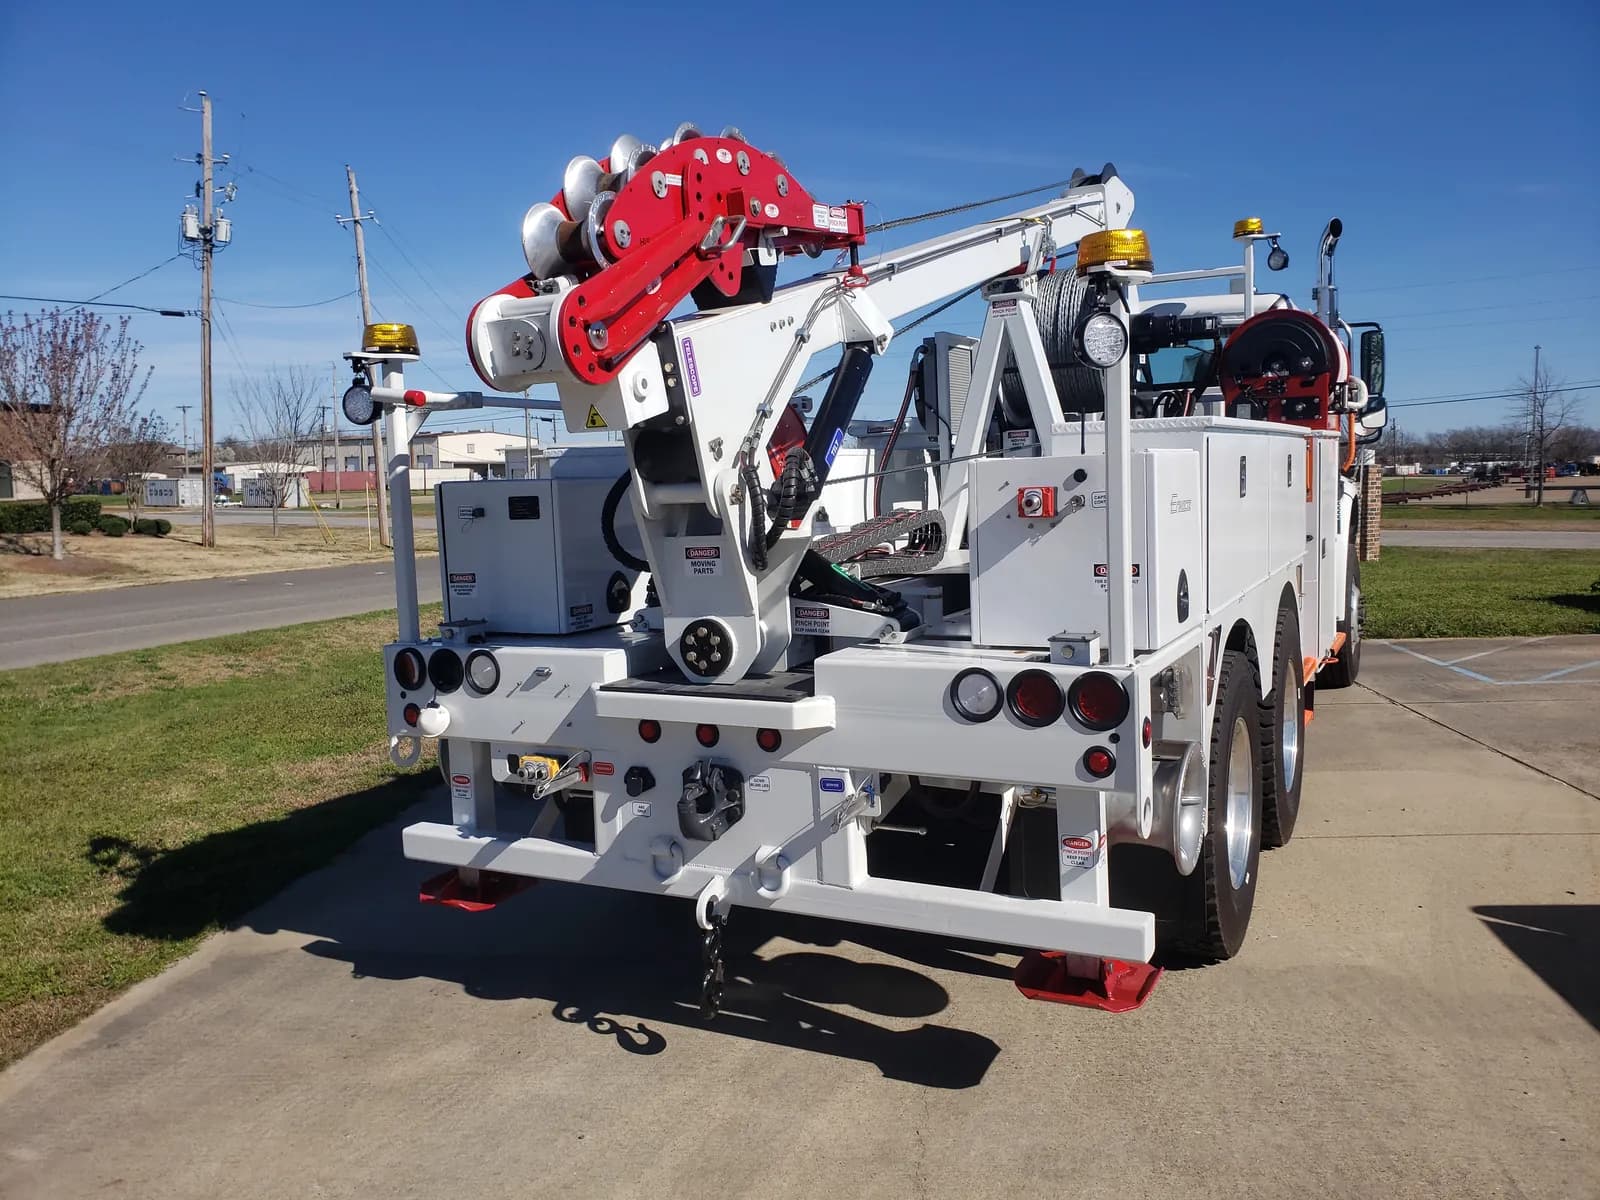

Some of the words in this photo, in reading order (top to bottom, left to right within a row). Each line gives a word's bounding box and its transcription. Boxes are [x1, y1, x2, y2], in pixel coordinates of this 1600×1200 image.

[684, 341, 699, 394] TELESCOPE
[830, 439, 839, 457] TILT
[690, 549, 716, 557] DANGER
[690, 560, 716, 568] MOVING
[693, 567, 714, 575] PARTS
